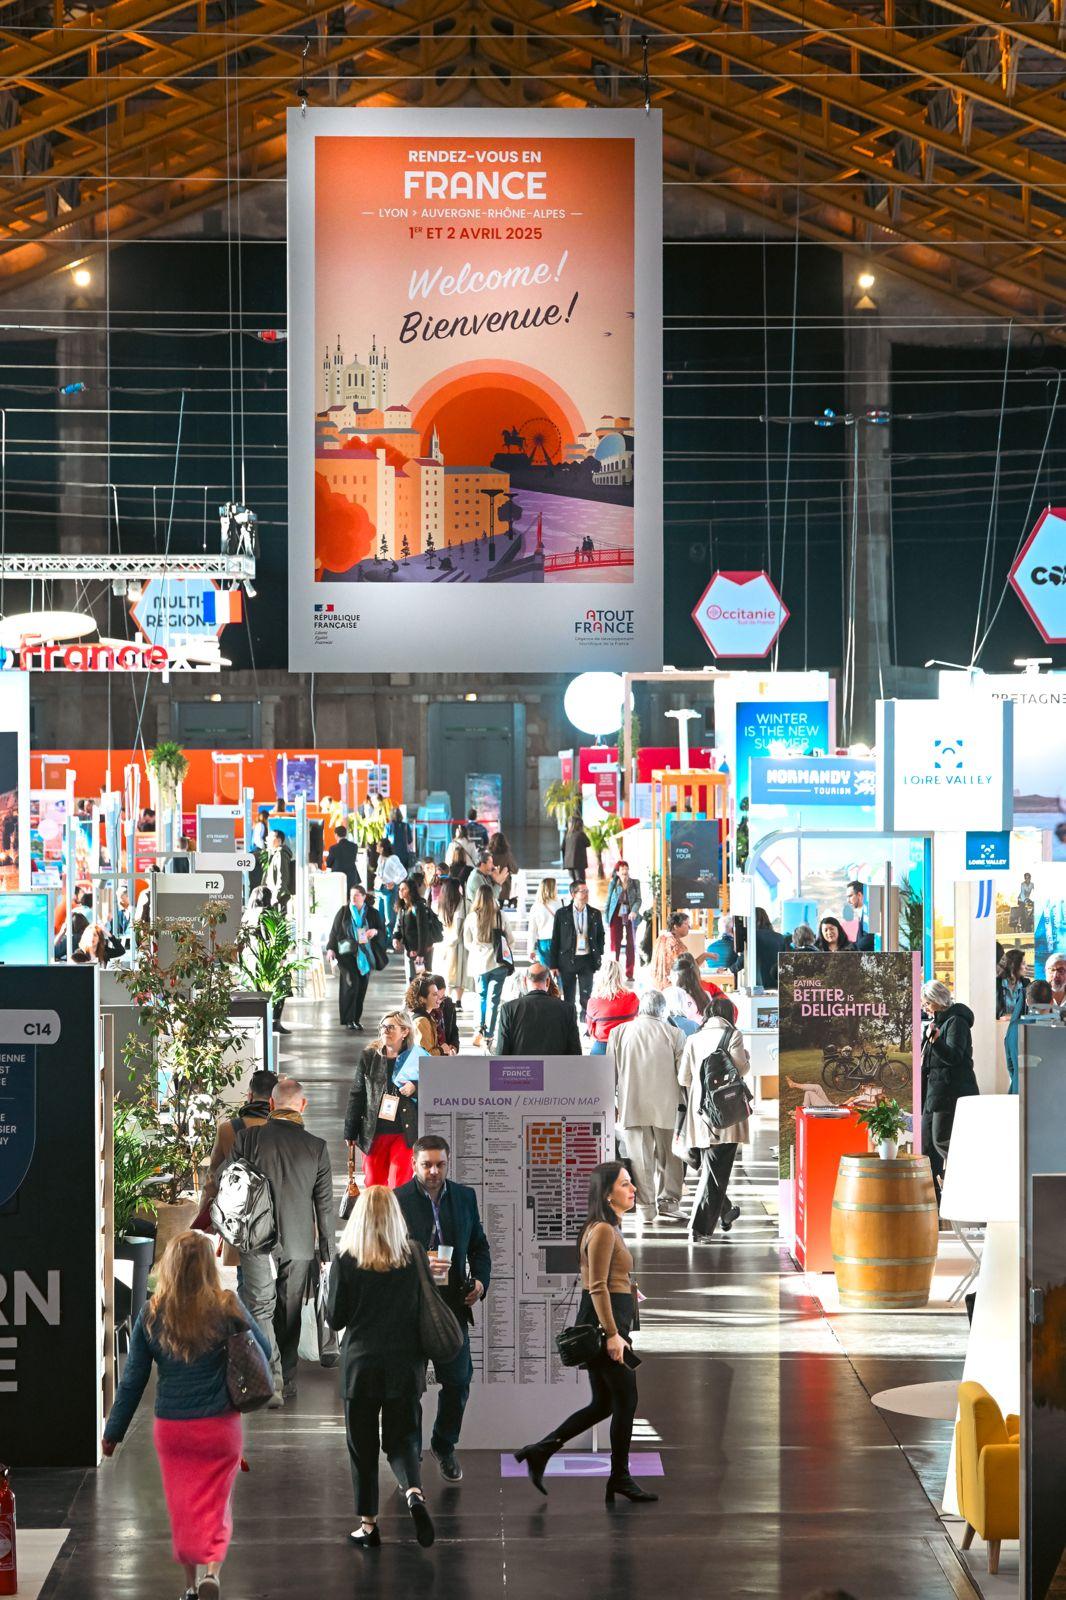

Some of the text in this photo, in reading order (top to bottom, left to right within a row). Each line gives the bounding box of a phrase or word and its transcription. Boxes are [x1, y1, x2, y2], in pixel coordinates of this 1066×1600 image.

[408, 150, 542, 163] RENDEZ-VOUS EN
[404, 171, 547, 200] FRANCE
[379, 208, 408, 218] LYON
[421, 206, 566, 219] AUVERGNE-RHÔNE-ALPES
[427, 227, 443, 239] ET
[447, 227, 456, 239] 2
[459, 227, 501, 240] AVRIL
[506, 227, 543, 240] 2025
[408, 249, 568, 301] Welcome!
[399, 291, 579, 344] Bienvenue!
[586, 610, 634, 621] ATOUT
[706, 604, 776, 620] Occitanie
[314, 621, 357, 629] FRANÇAISE
[575, 621, 634, 633] FRANCE
[20, 633, 169, 671] France
[756, 713, 808, 725] WINTER
[744, 726, 819, 737] IS THE NEW
[766, 769, 851, 785] NORMANDY
[945, 775, 992, 785] VALLEY
[814, 787, 851, 795] TOURISM
[236, 859, 251, 868] G12
[205, 880, 219, 890] F12
[793, 989, 844, 1002] BETTER
[801, 1003, 889, 1017] DELIGHTFUL
[24, 1023, 51, 1036] C14
[433, 1097, 459, 1106] PLAN
[461, 1097, 476, 1106] DU
[478, 1097, 512, 1106] SALON
[522, 1097, 575, 1106] EXHIBITION
[577, 1097, 600, 1106] MAP
